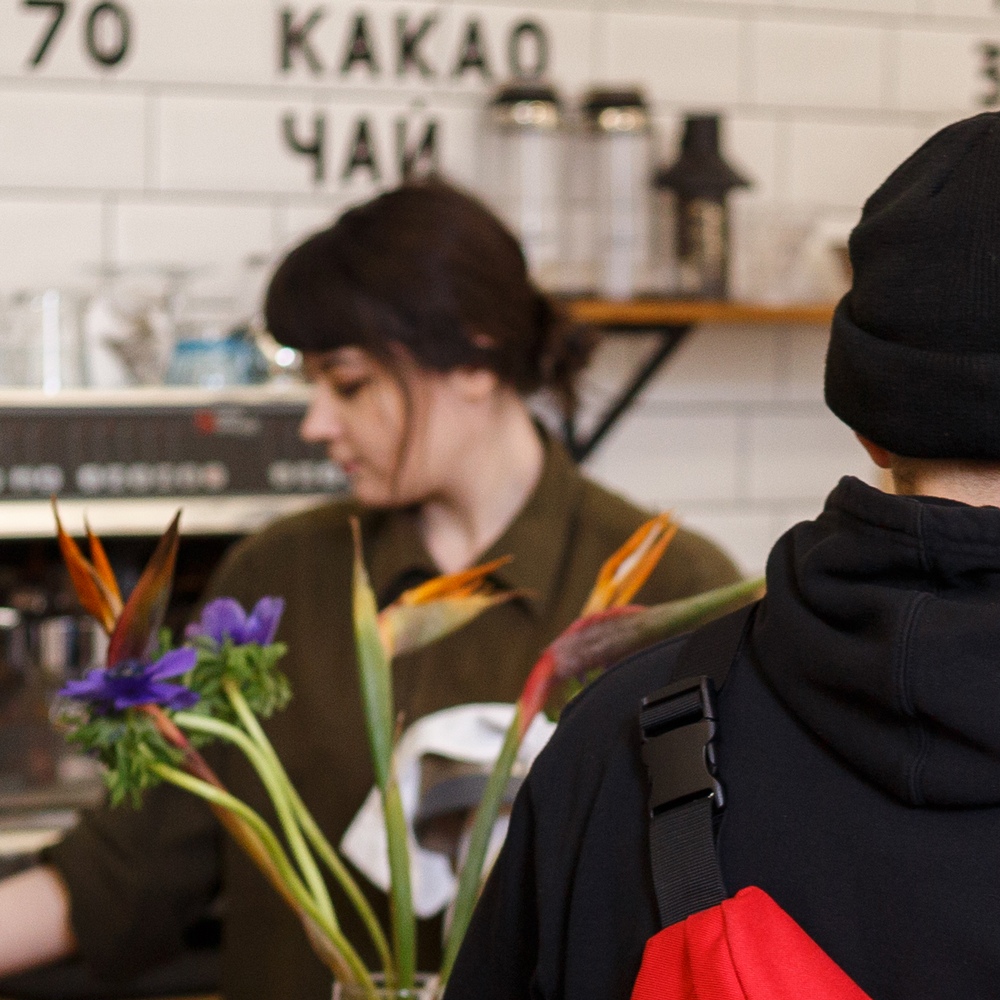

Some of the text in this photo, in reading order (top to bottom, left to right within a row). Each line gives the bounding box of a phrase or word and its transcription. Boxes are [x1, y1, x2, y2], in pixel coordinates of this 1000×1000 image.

[23, 0, 131, 68] 70
[279, 6, 550, 81] КАКАО
[281, 98, 438, 182] ЧАЙ
